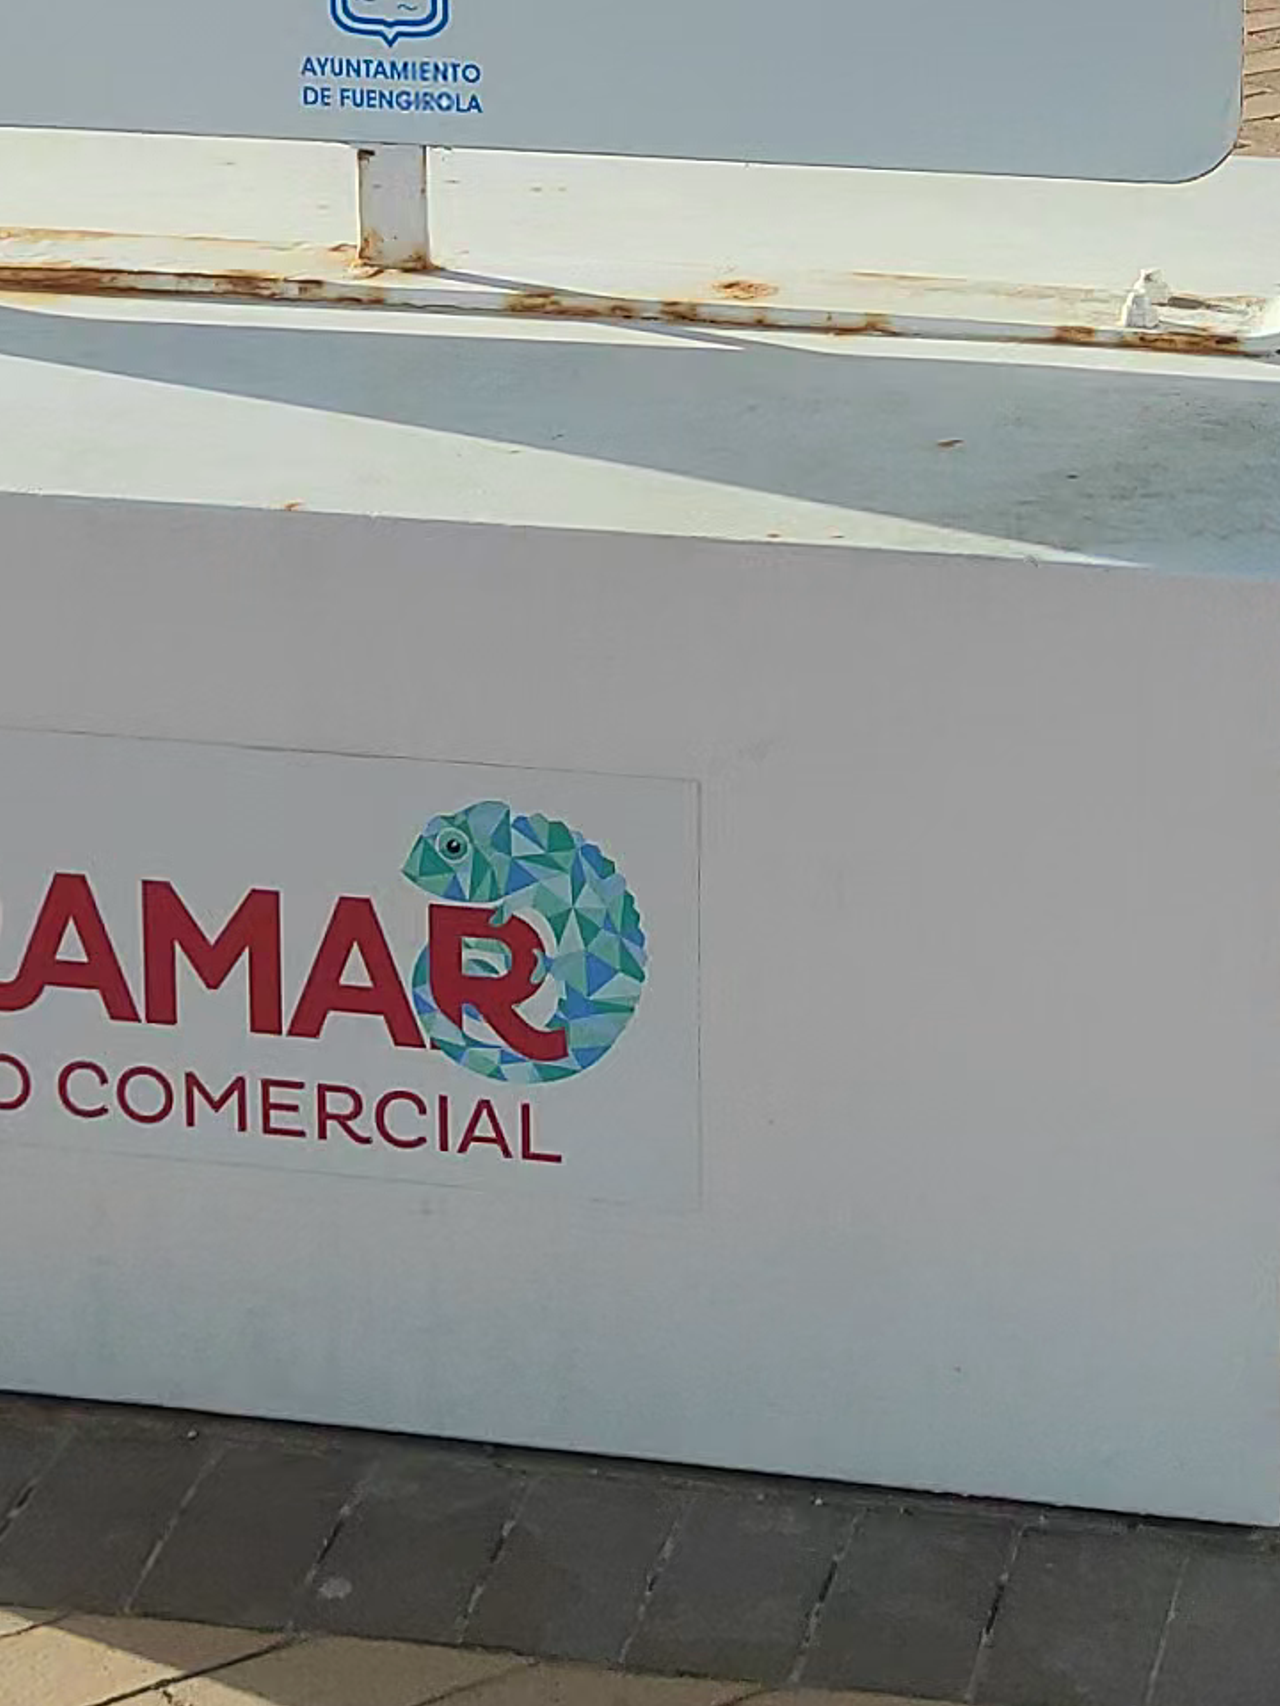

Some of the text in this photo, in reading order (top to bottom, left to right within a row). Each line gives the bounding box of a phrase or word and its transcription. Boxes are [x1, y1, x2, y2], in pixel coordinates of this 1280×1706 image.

[301, 56, 481, 84] AYUNTAMIENTO
[302, 86, 483, 113] DE FUENGIROLA
[56, 1061, 563, 1165] COMERCIAL
